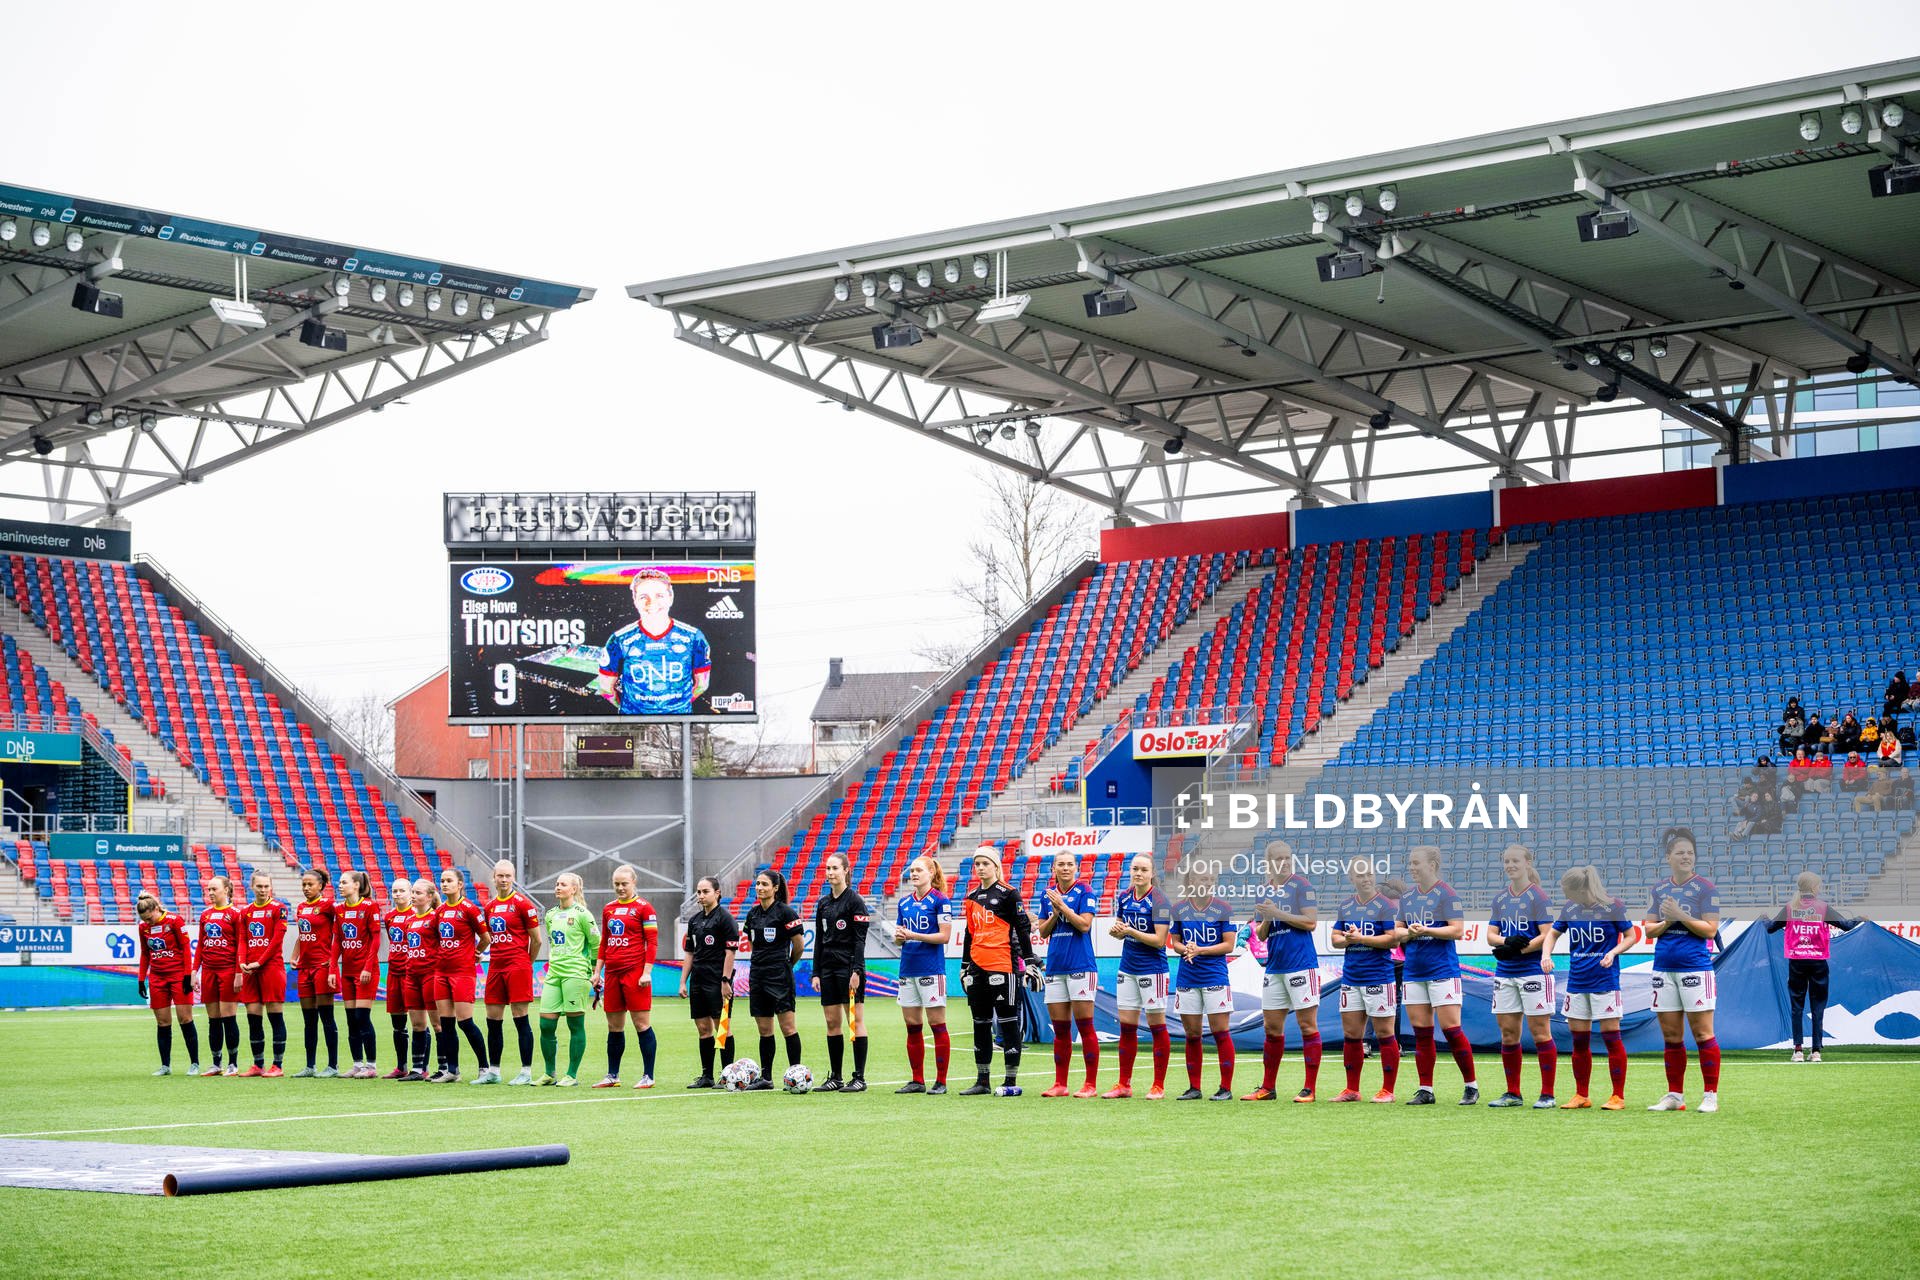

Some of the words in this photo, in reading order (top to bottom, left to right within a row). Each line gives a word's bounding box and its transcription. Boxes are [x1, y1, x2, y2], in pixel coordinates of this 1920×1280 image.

[40, 207, 56, 217] DNB
[140, 224, 156, 234] DNB
[233, 241, 248, 251] DNB
[324, 256, 338, 266] DNB
[466, 496, 602, 536] intility
[617, 503, 734, 529] arena
[83, 534, 107, 553] DNB
[706, 566, 742, 588] DNB
[461, 599, 489, 614] Elise
[489, 599, 518, 614] Hove
[705, 609, 745, 619] adidas
[461, 613, 586, 646] Thorsnes
[630, 655, 684, 692] DNB
[494, 663, 517, 706] 9
[6, 736, 36, 758] DNB
[578, 739, 586, 749] H
[625, 738, 633, 749] G
[1032, 830, 1097, 847] OsloTaxi
[1500, 910, 1529, 936] DNB
[1792, 924, 1820, 935] VERT
[15, 928, 65, 943] ULNA
[1182, 922, 1217, 945] DNB
[1570, 921, 1606, 949] DNB
